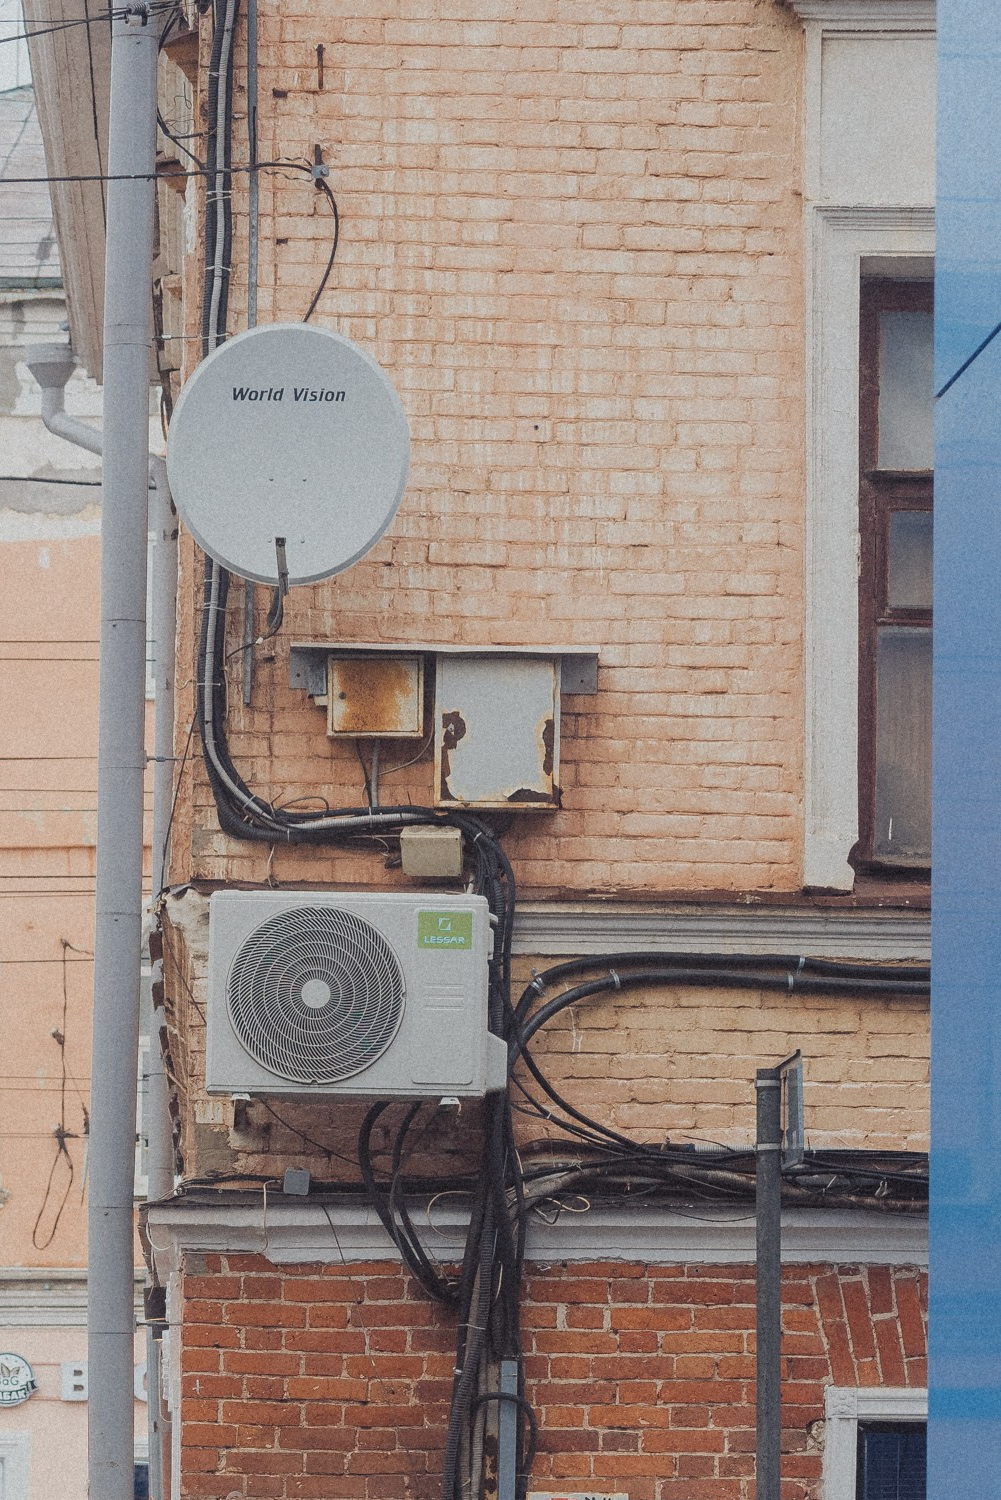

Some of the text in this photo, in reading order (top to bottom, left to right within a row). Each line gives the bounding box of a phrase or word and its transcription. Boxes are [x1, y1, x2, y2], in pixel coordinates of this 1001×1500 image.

[232, 387, 346, 402] World Vision
[424, 936, 465, 944] LESSAR
